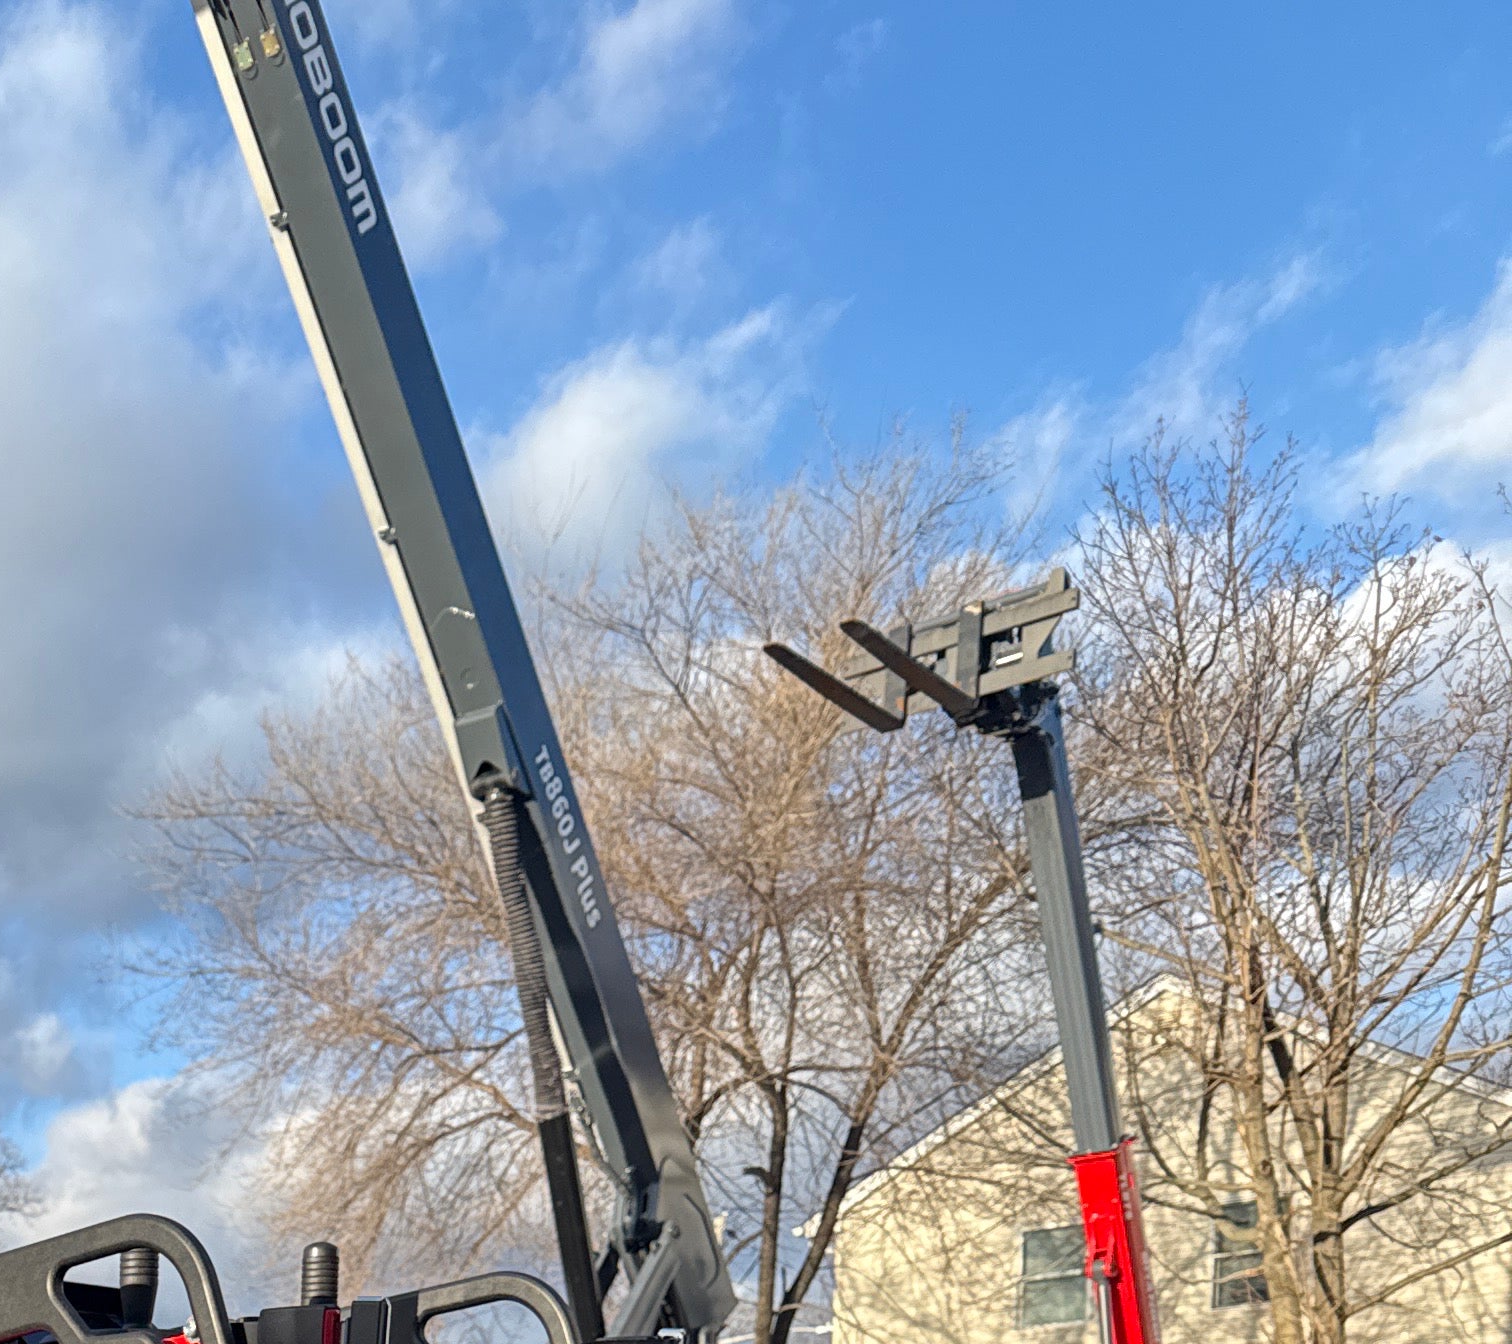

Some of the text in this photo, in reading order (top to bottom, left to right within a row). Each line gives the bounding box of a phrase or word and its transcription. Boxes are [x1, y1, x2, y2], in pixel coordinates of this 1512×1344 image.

[285, 0, 377, 234] OBOOM
[535, 744, 602, 928] TB860J Plus
